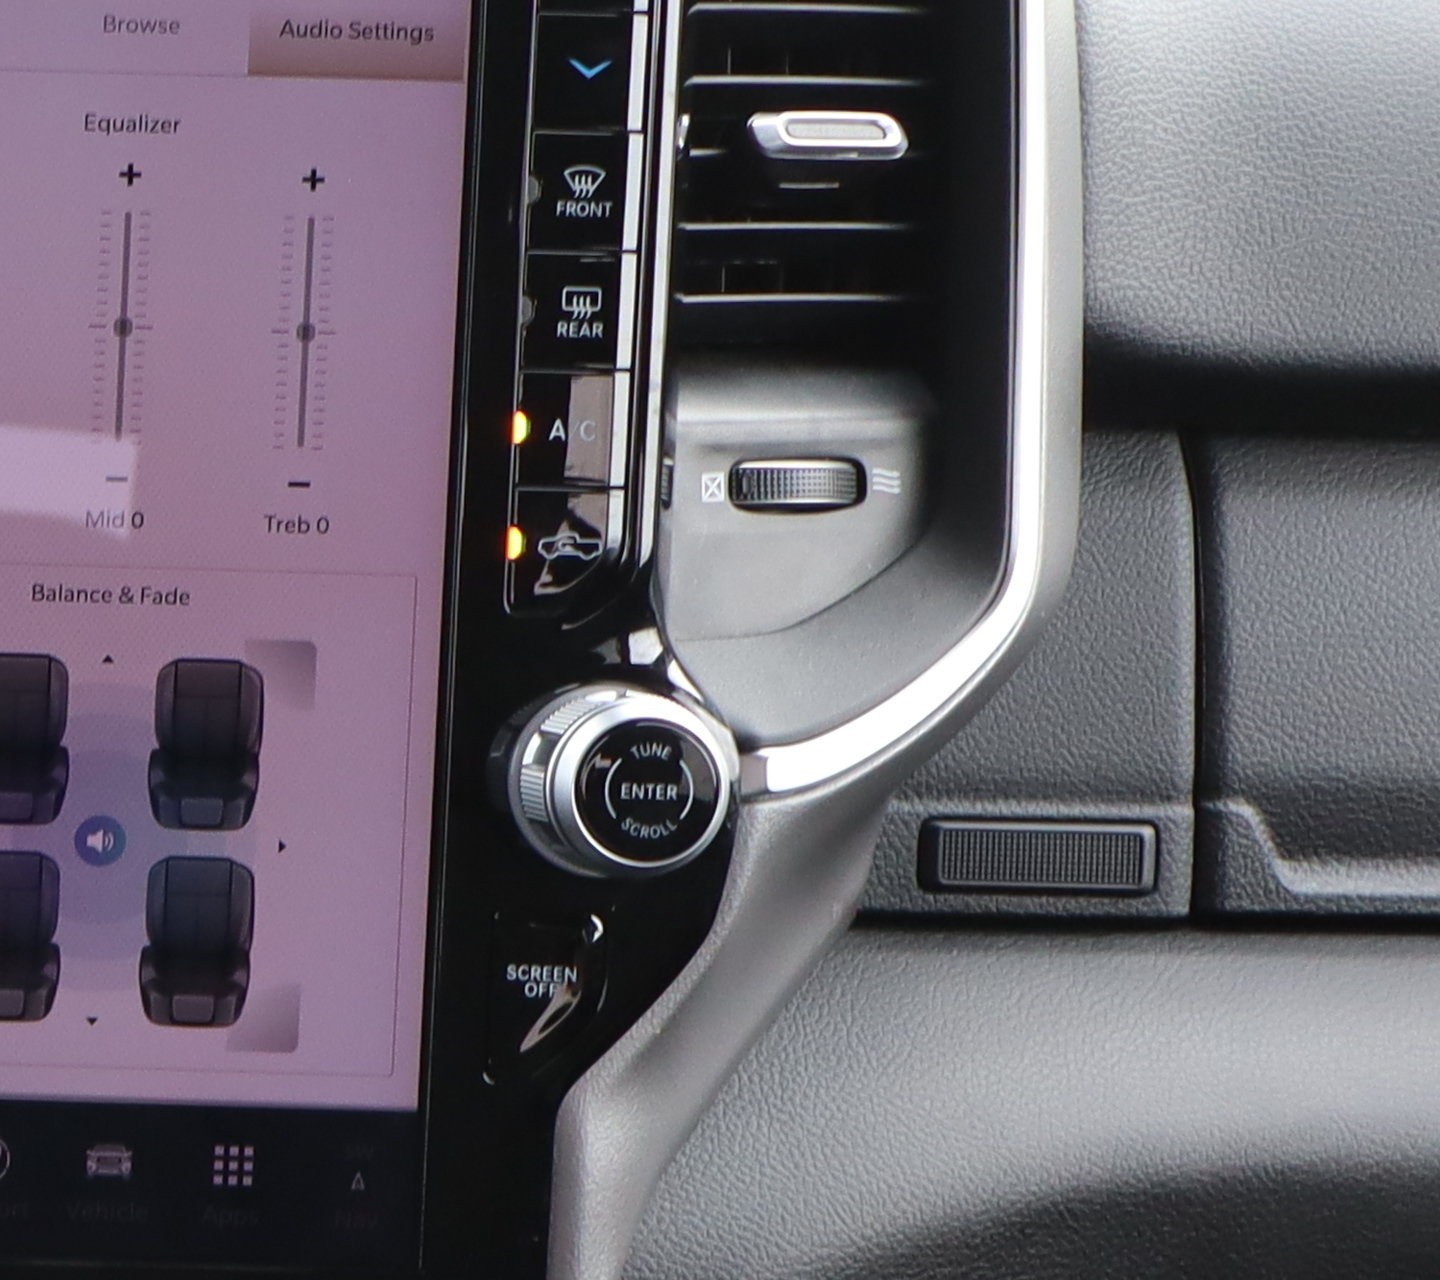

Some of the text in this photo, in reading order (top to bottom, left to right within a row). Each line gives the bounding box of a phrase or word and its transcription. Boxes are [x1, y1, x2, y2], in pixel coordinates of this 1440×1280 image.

[103, 15, 180, 36] Browse
[280, 18, 434, 45] Audio Settings
[84, 113, 181, 136] Equalizer
[556, 200, 613, 218] FRONT
[556, 322, 604, 339] REAR
[548, 418, 597, 442] A/C
[85, 509, 145, 530] Mid 0
[264, 514, 330, 535] Treb 0
[31, 583, 191, 606] Balance & Fade
[630, 741, 672, 761] TUNE
[620, 783, 678, 801] ENTER
[620, 817, 679, 840] SCROLL
[506, 964, 577, 983] SCREEN
[524, 982, 558, 998] OFF
